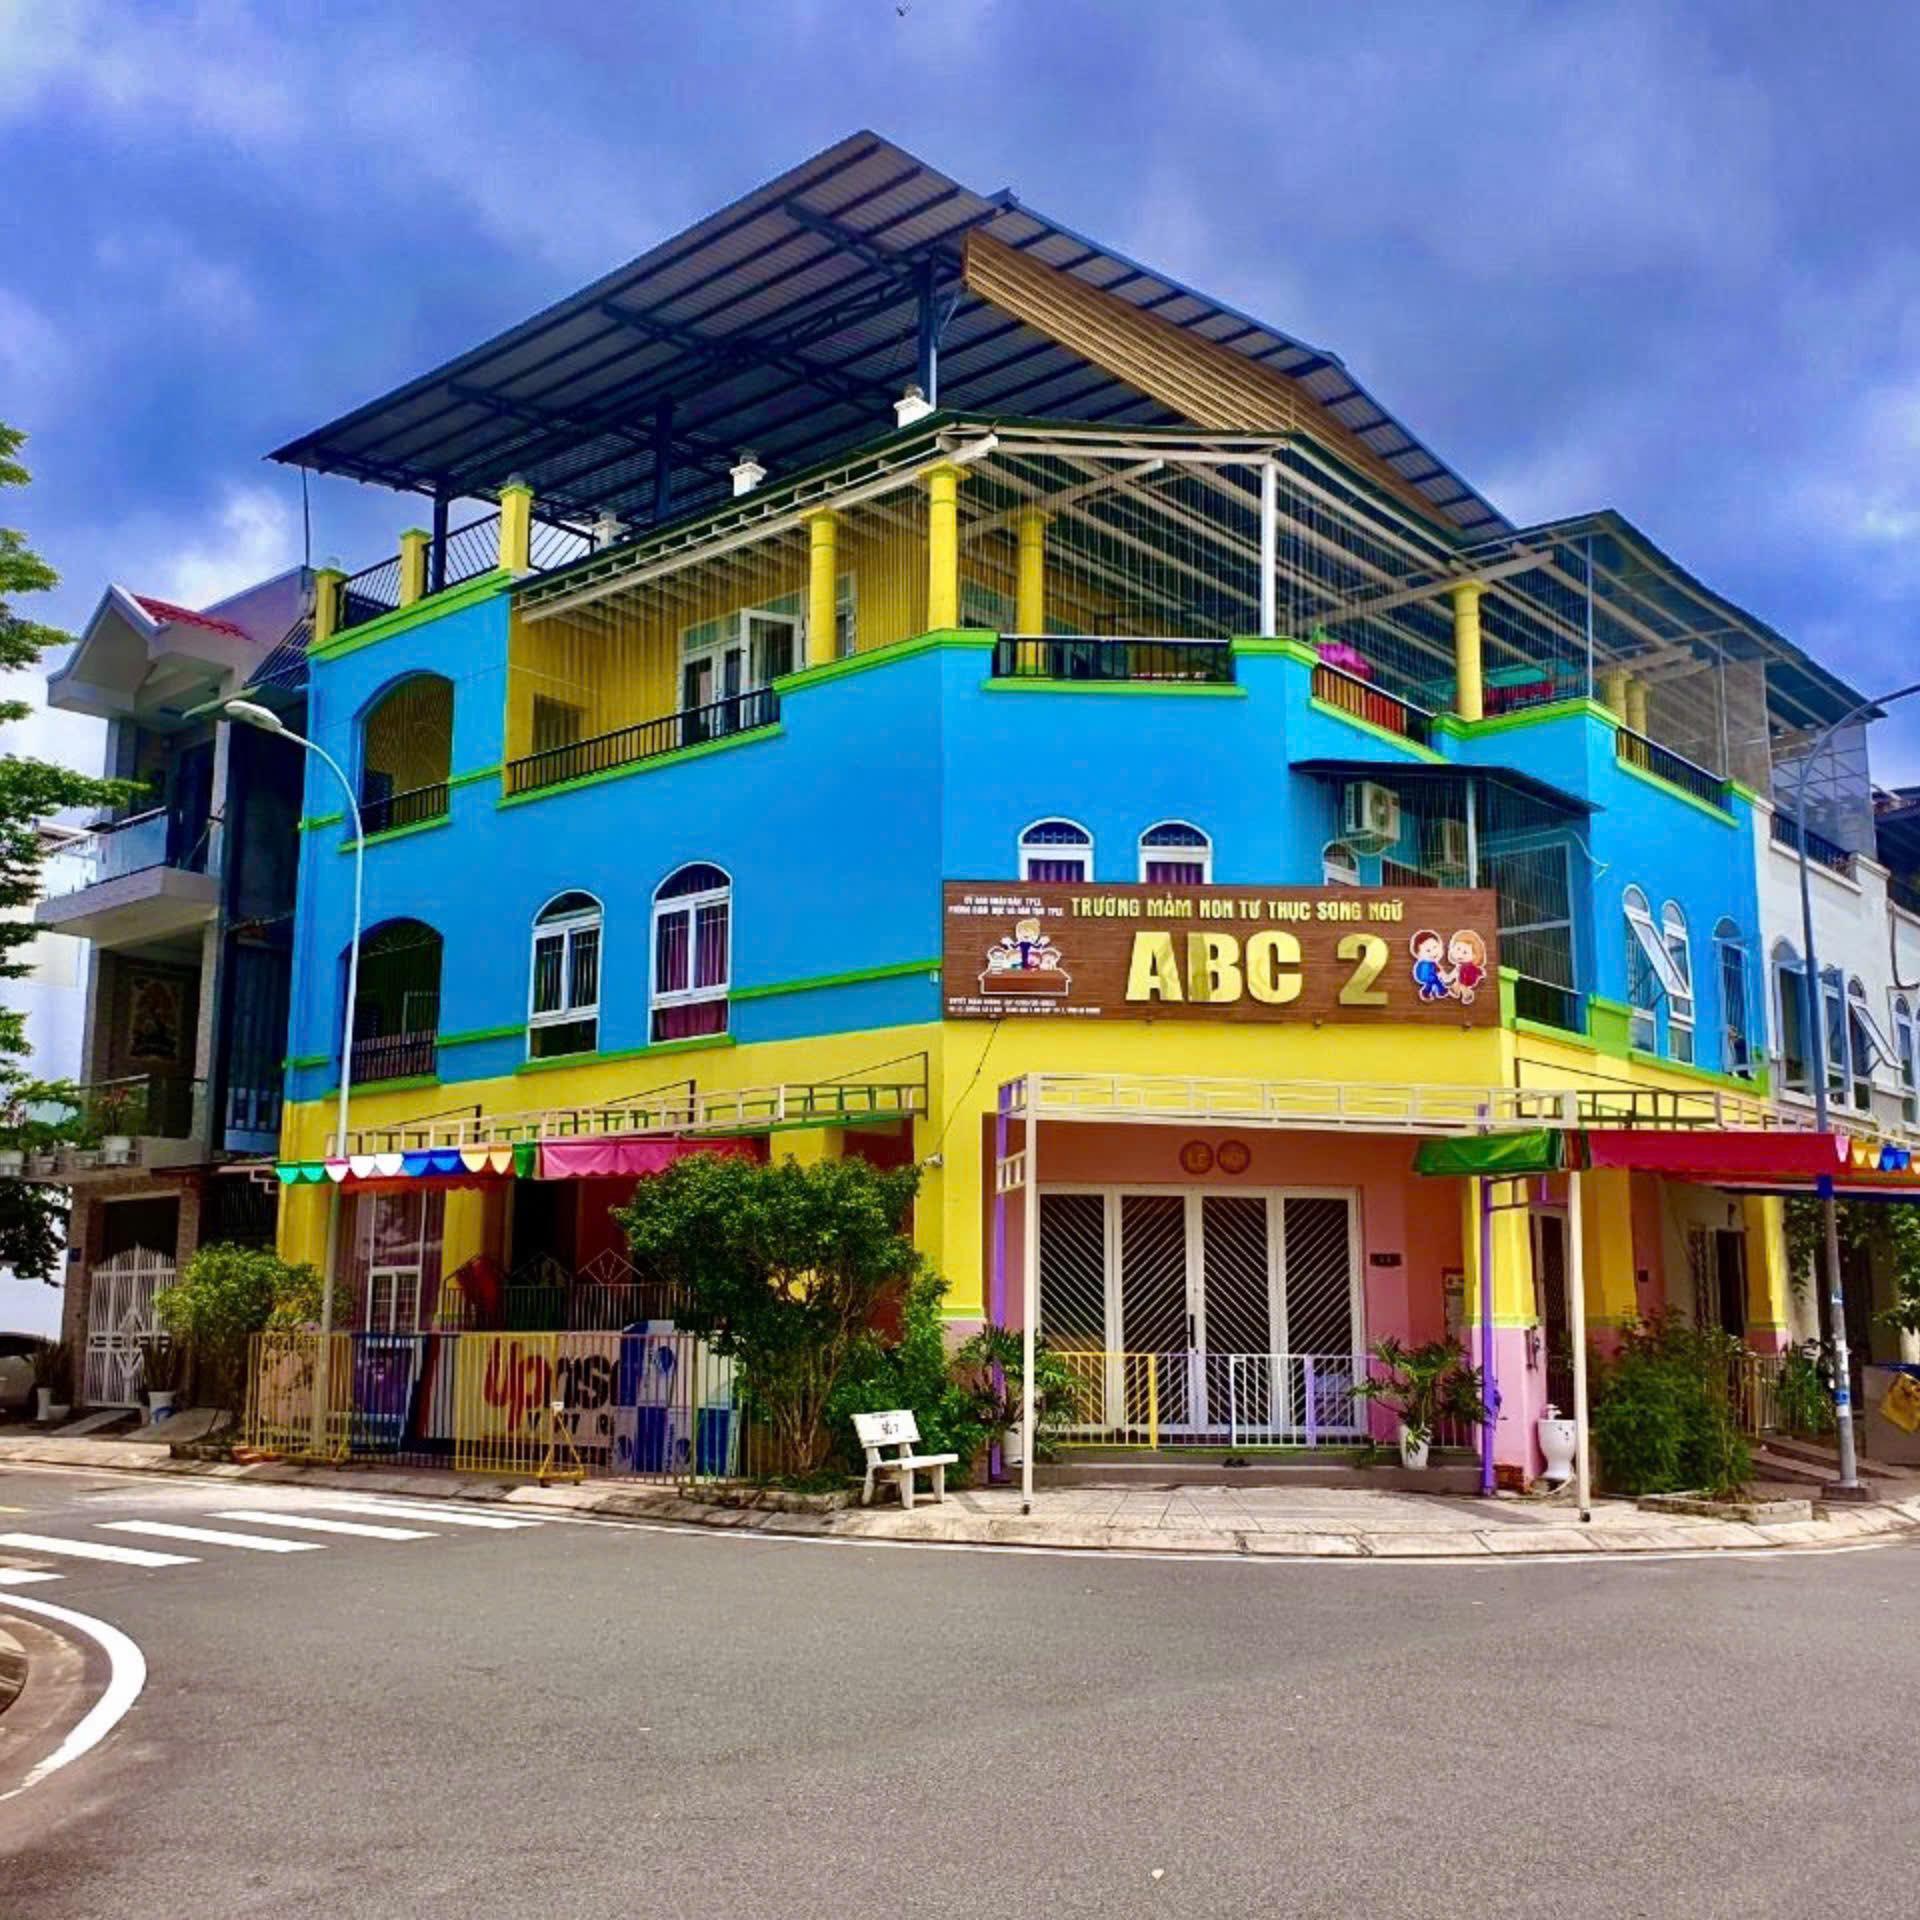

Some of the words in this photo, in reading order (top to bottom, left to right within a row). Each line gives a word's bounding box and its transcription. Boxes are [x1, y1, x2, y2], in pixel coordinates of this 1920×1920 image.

[1071, 893, 1140, 917] TRƯỜNG
[1200, 899, 1234, 918] NON
[1239, 898, 1262, 919] TƯ
[1267, 900, 1312, 923] THỤC
[1368, 898, 1404, 921] NGỮ
[1126, 930, 1303, 1004] ABC
[1337, 933, 1389, 1005] 2
